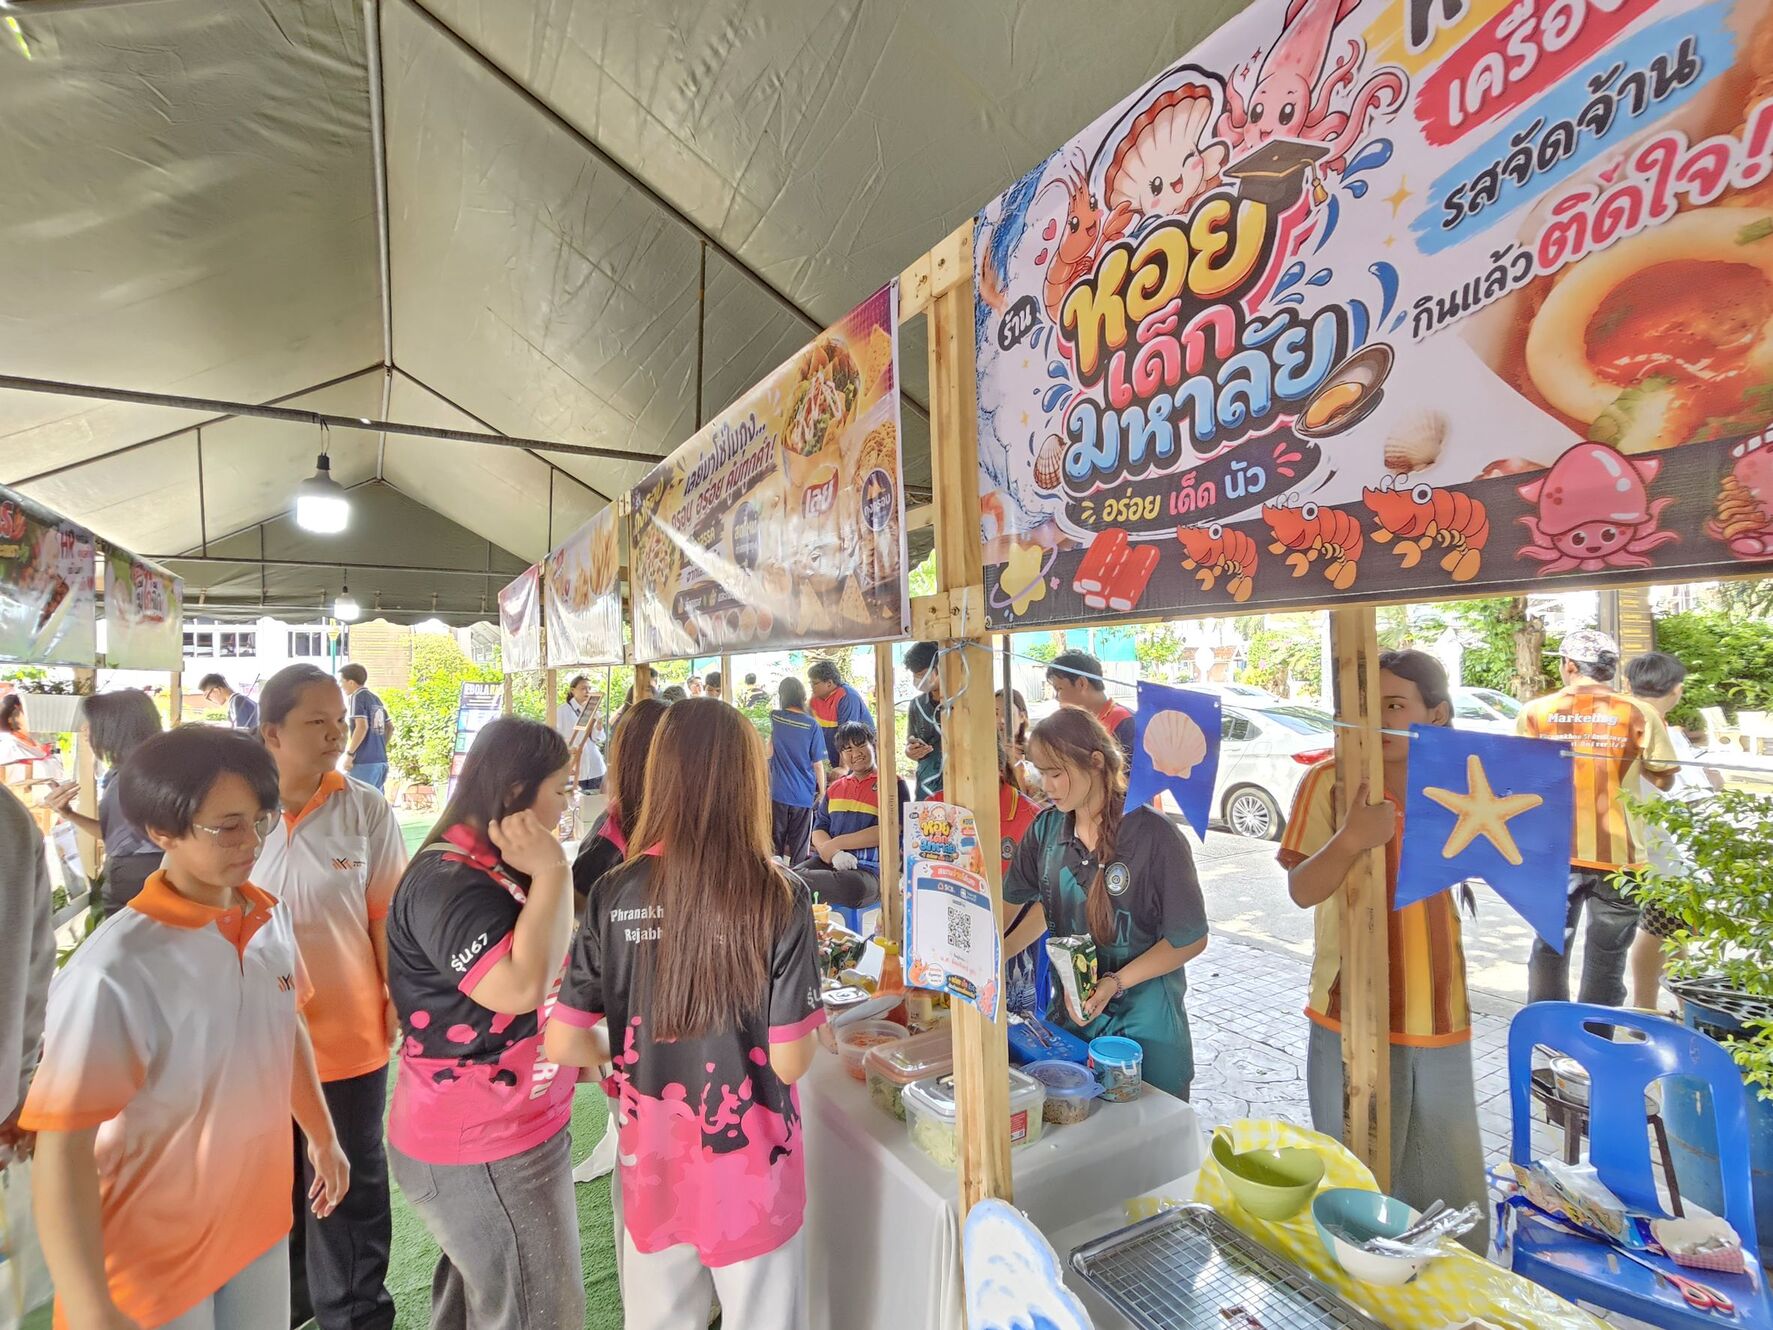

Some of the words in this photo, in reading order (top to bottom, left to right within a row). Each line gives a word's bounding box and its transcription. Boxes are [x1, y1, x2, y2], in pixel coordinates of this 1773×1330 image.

[1443, 37, 1697, 229] รสจัดจ้าน
[1063, 199, 1268, 375] หอย
[1003, 304, 1032, 348] ร้าน
[1109, 299, 1236, 409] เด็ก
[1065, 311, 1337, 482] มหาลัย
[1102, 488, 1162, 522] อร่อย
[1169, 472, 1217, 516] เด็ด
[1224, 460, 1266, 499] นัว
[1547, 712, 1617, 726] Marketing
[610, 905, 665, 922] Phranakh
[451, 932, 489, 973] รุ่น67
